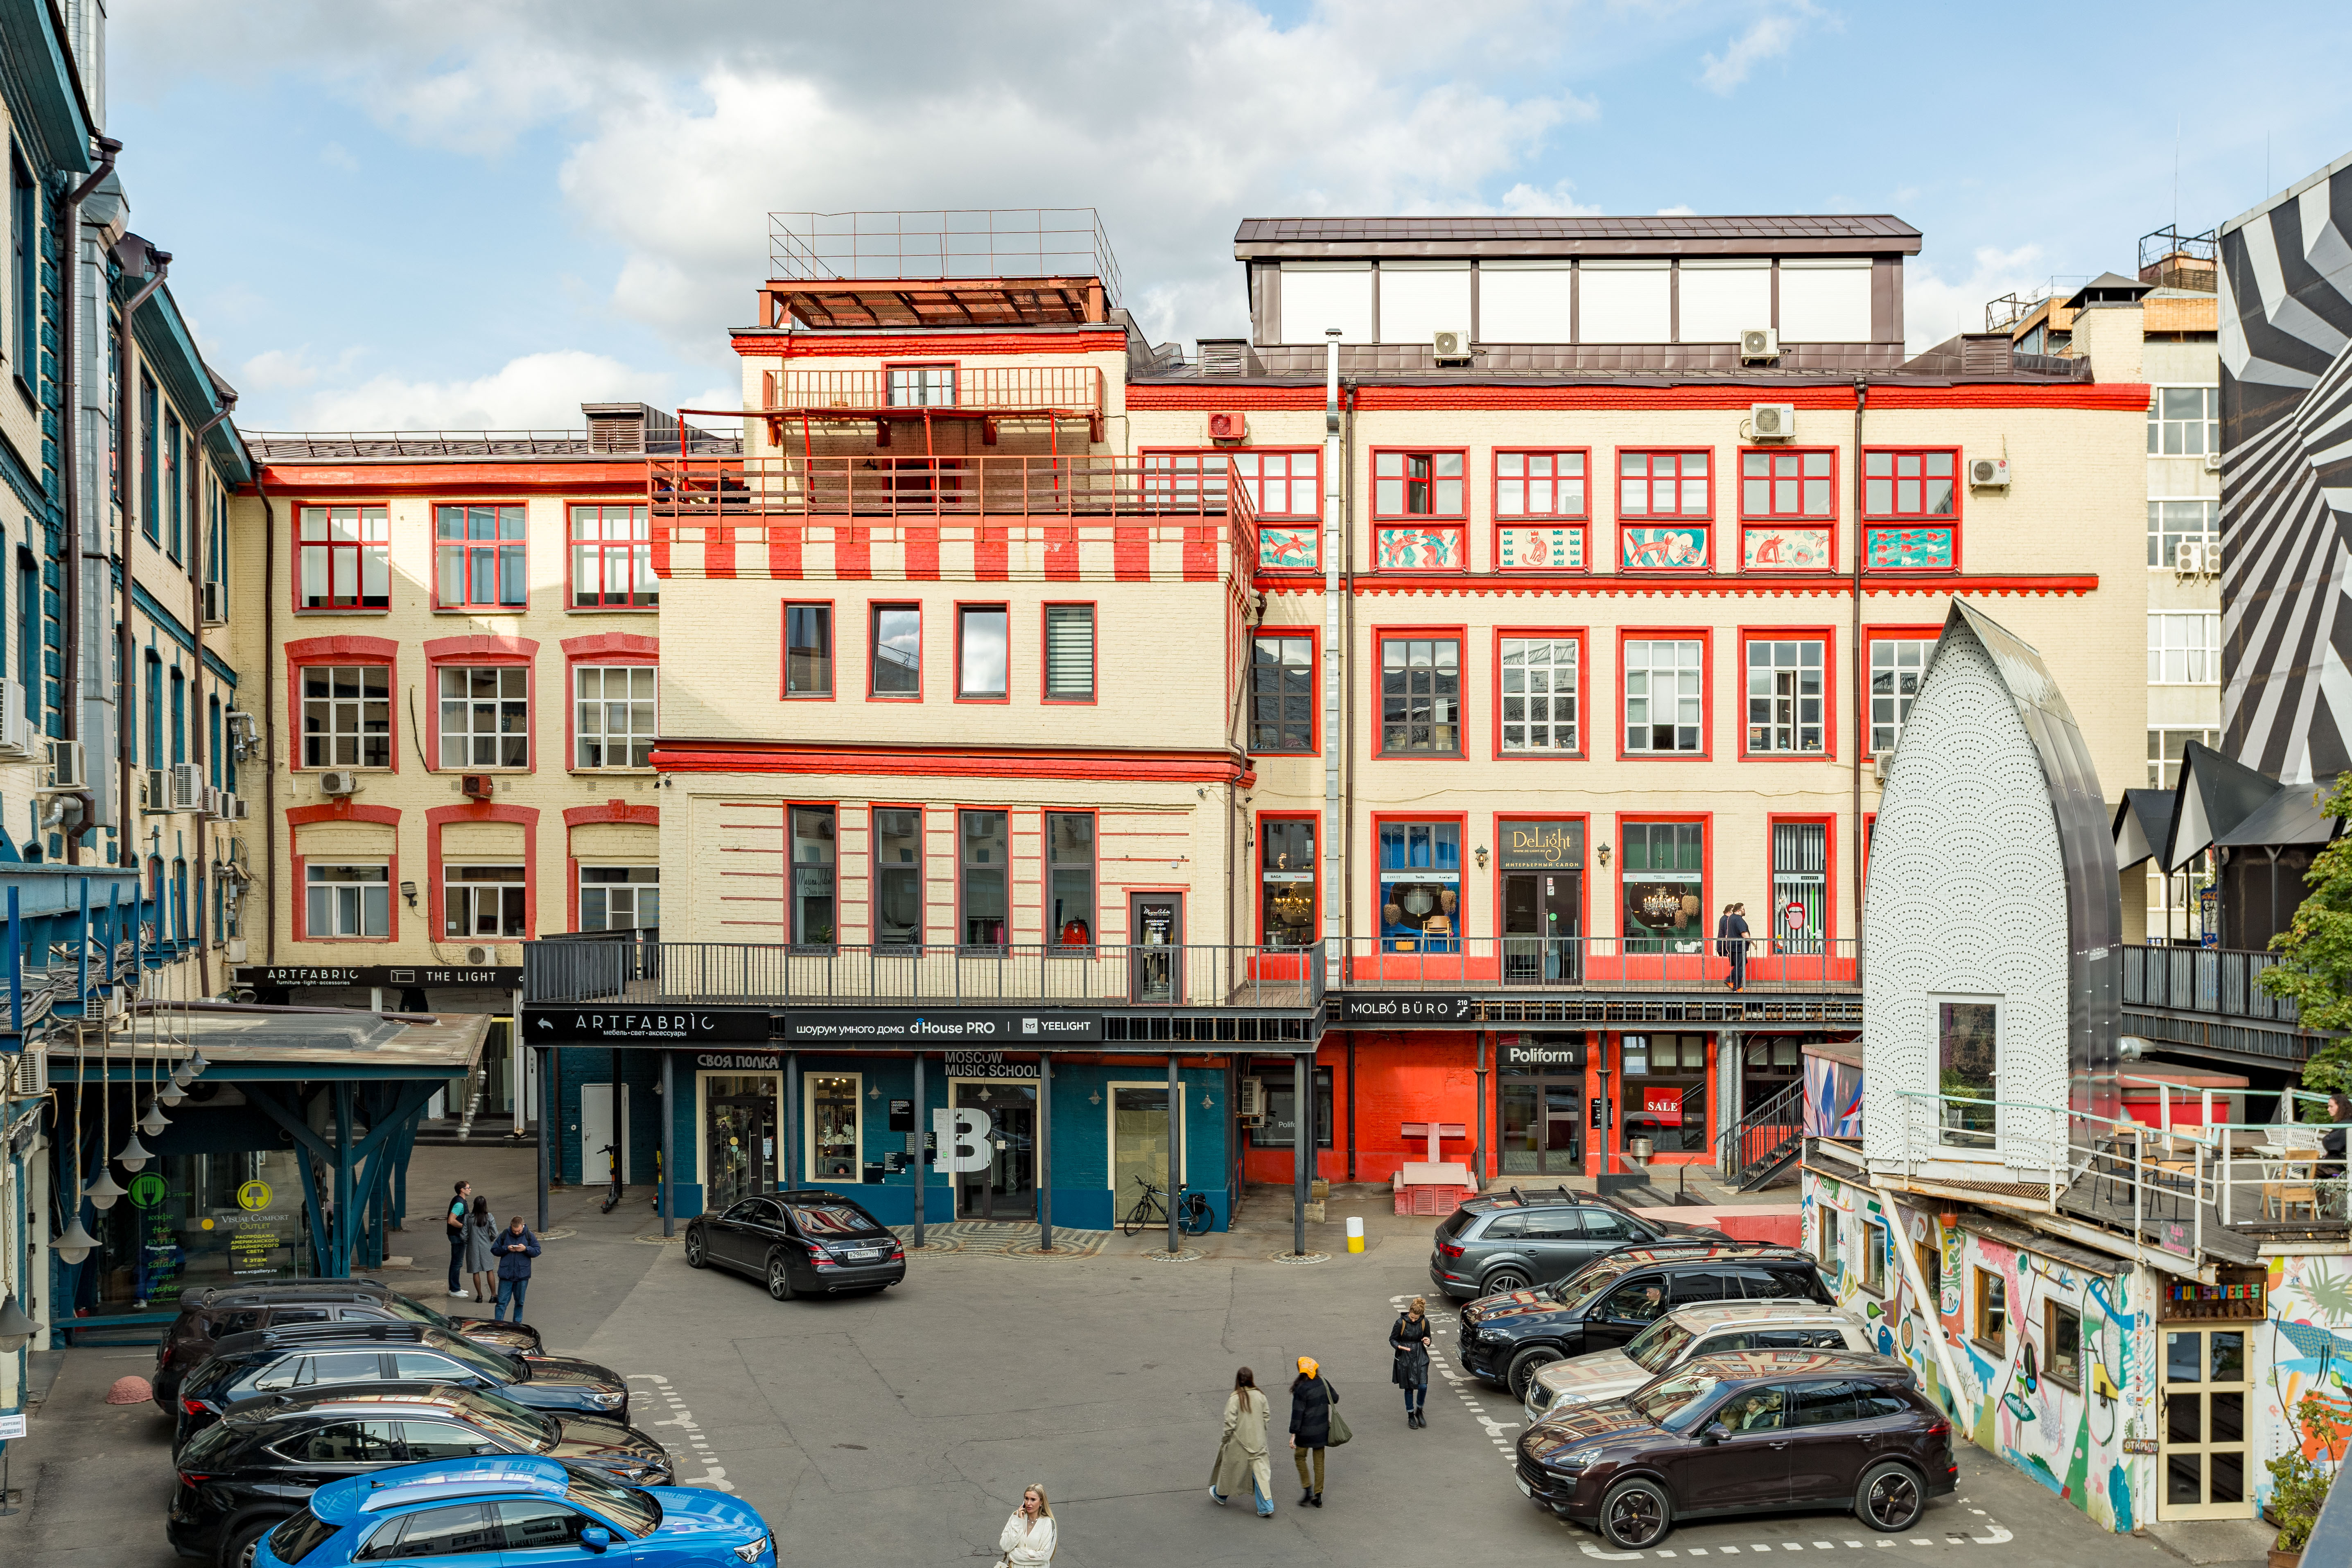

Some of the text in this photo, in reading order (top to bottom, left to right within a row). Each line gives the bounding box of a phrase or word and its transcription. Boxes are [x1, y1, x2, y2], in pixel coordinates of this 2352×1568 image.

[1513, 827, 1571, 862] DeLight
[426, 972, 496, 981] THE LIGHT
[1351, 1000, 1448, 1014] MOLBÓ BÜRO
[796, 1024, 904, 1035] шоурум умного дома
[967, 1022, 995, 1034] PRO
[1041, 1021, 1091, 1031] YEELIGHT
[945, 1051, 1003, 1064] MOSCOW
[1510, 1048, 1573, 1063] Poliform
[697, 1054, 779, 1069] СВОЯ ПОЛКА
[945, 1064, 1041, 1078] MUSIC SCHOOL
[1648, 1101, 1678, 1112] SALE
[148, 1213, 174, 1222] кофе
[148, 1258, 176, 1269] salad
[147, 1284, 180, 1293] water
[2167, 1286, 2211, 1300] FRUITS
[2219, 1283, 2260, 1299] VEGES
[2125, 1441, 2158, 1452] ОТКРЫТО
